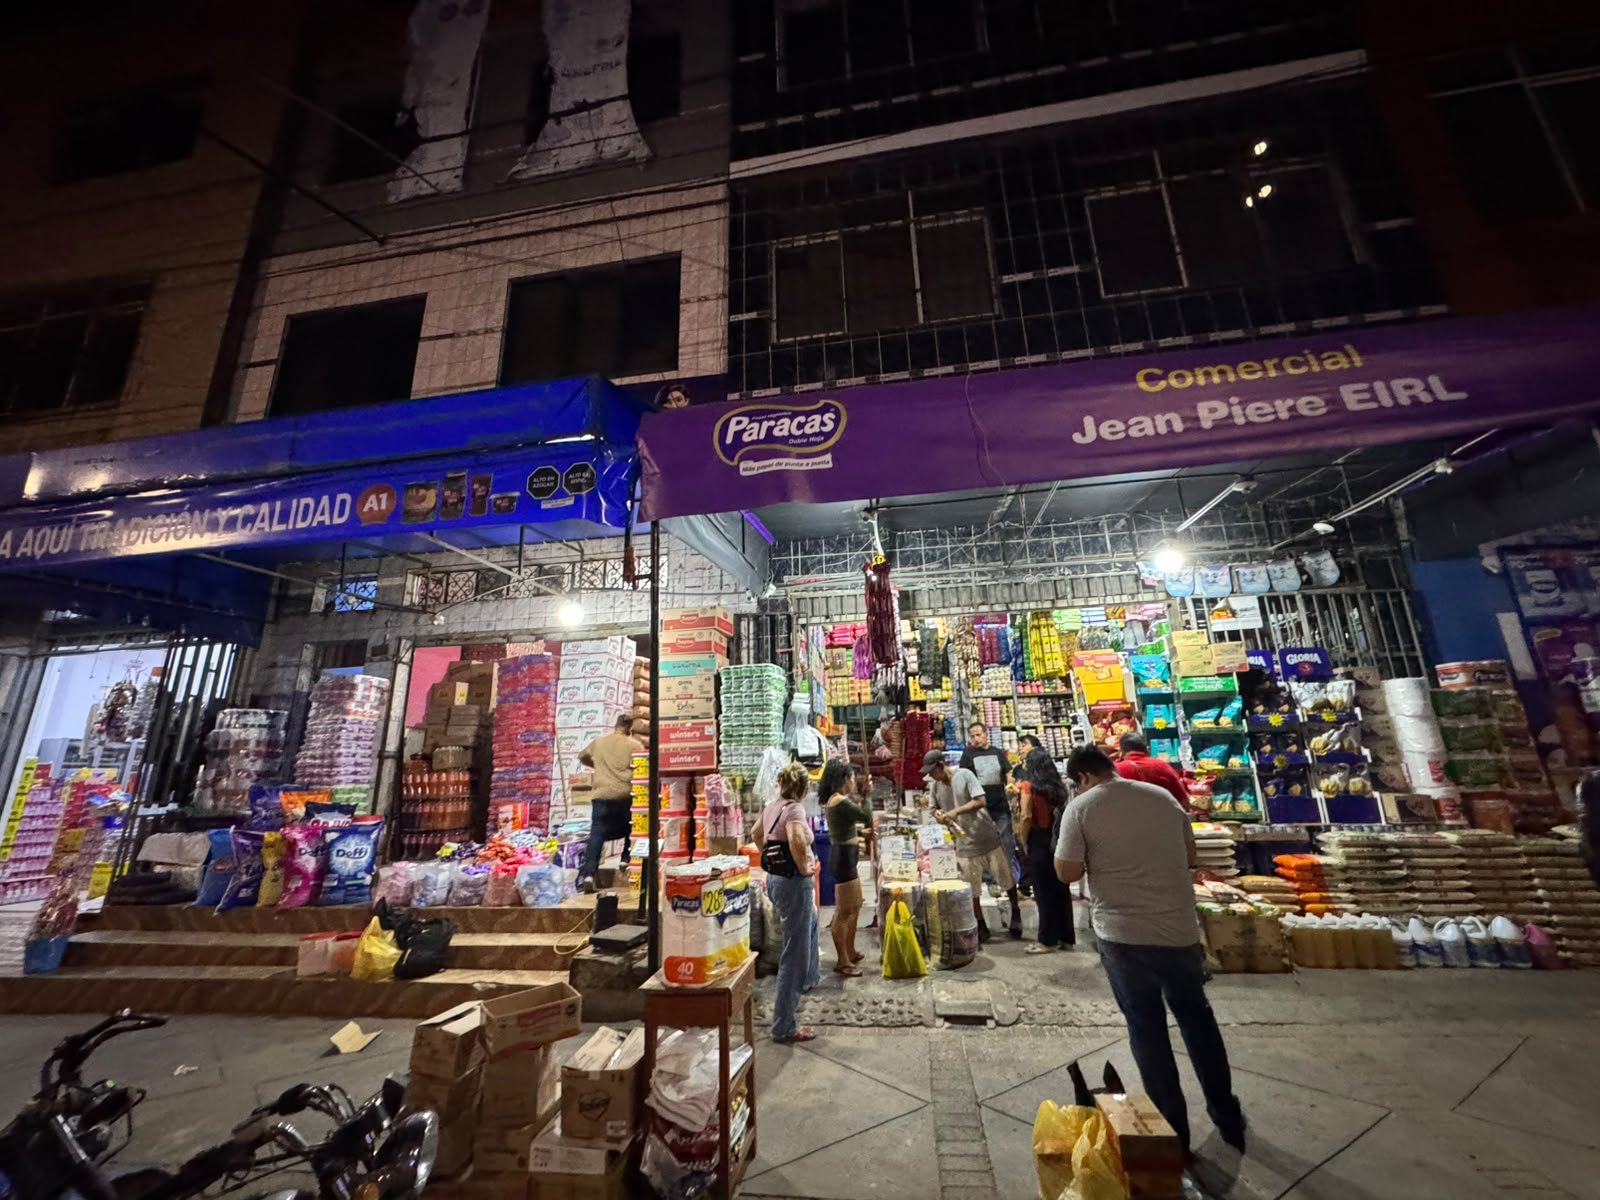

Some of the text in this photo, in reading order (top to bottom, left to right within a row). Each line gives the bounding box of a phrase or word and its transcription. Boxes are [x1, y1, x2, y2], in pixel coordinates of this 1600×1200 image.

[1135, 344, 1364, 393] Comercial
[1071, 374, 1469, 445] Jean Piere EIRL
[725, 412, 837, 445] Paracas
[362, 492, 389, 513] A1
[16, 516, 79, 560] AQUÍ
[80, 504, 209, 551] TRADICIÓN
[214, 506, 233, 536] Y
[236, 492, 353, 536] CALIDAD
[1285, 652, 1322, 666] GLORIA
[677, 961, 695, 974] 40
